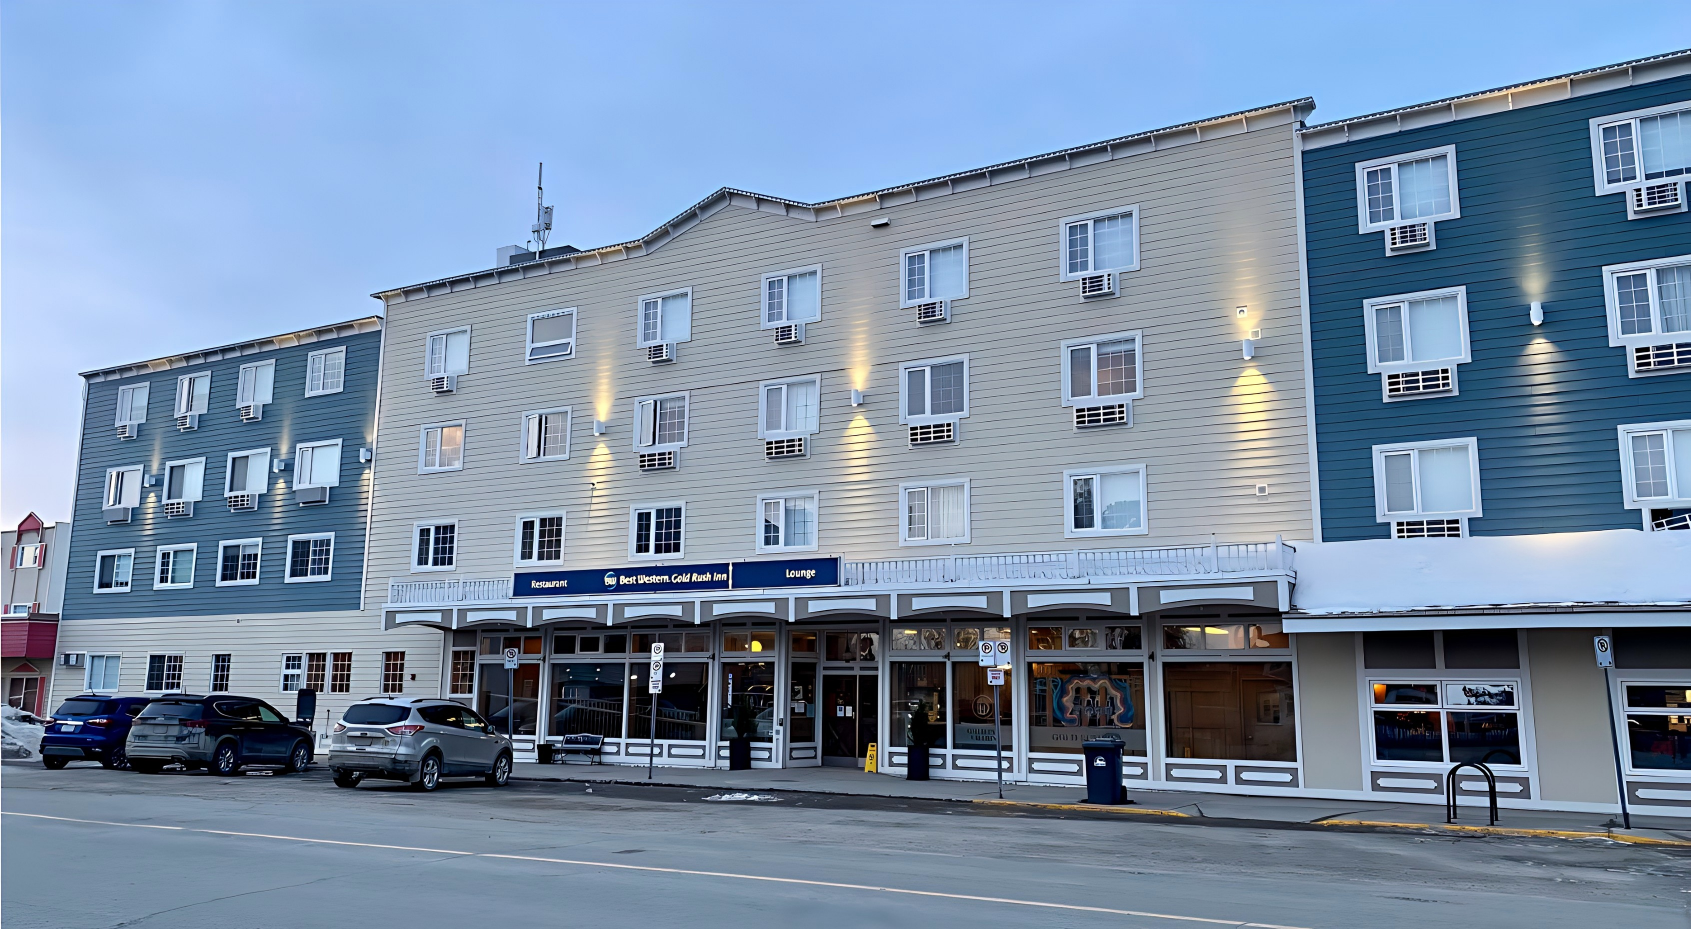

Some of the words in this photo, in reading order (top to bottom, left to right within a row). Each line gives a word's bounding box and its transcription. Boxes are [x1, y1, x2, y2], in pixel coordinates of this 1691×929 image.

[619, 575, 637, 585] Best
[671, 572, 691, 583] Gold
[691, 571, 712, 582] Rush
[713, 571, 727, 581] Inn
[786, 569, 816, 579] Lounge
[531, 579, 568, 589] Restaurant
